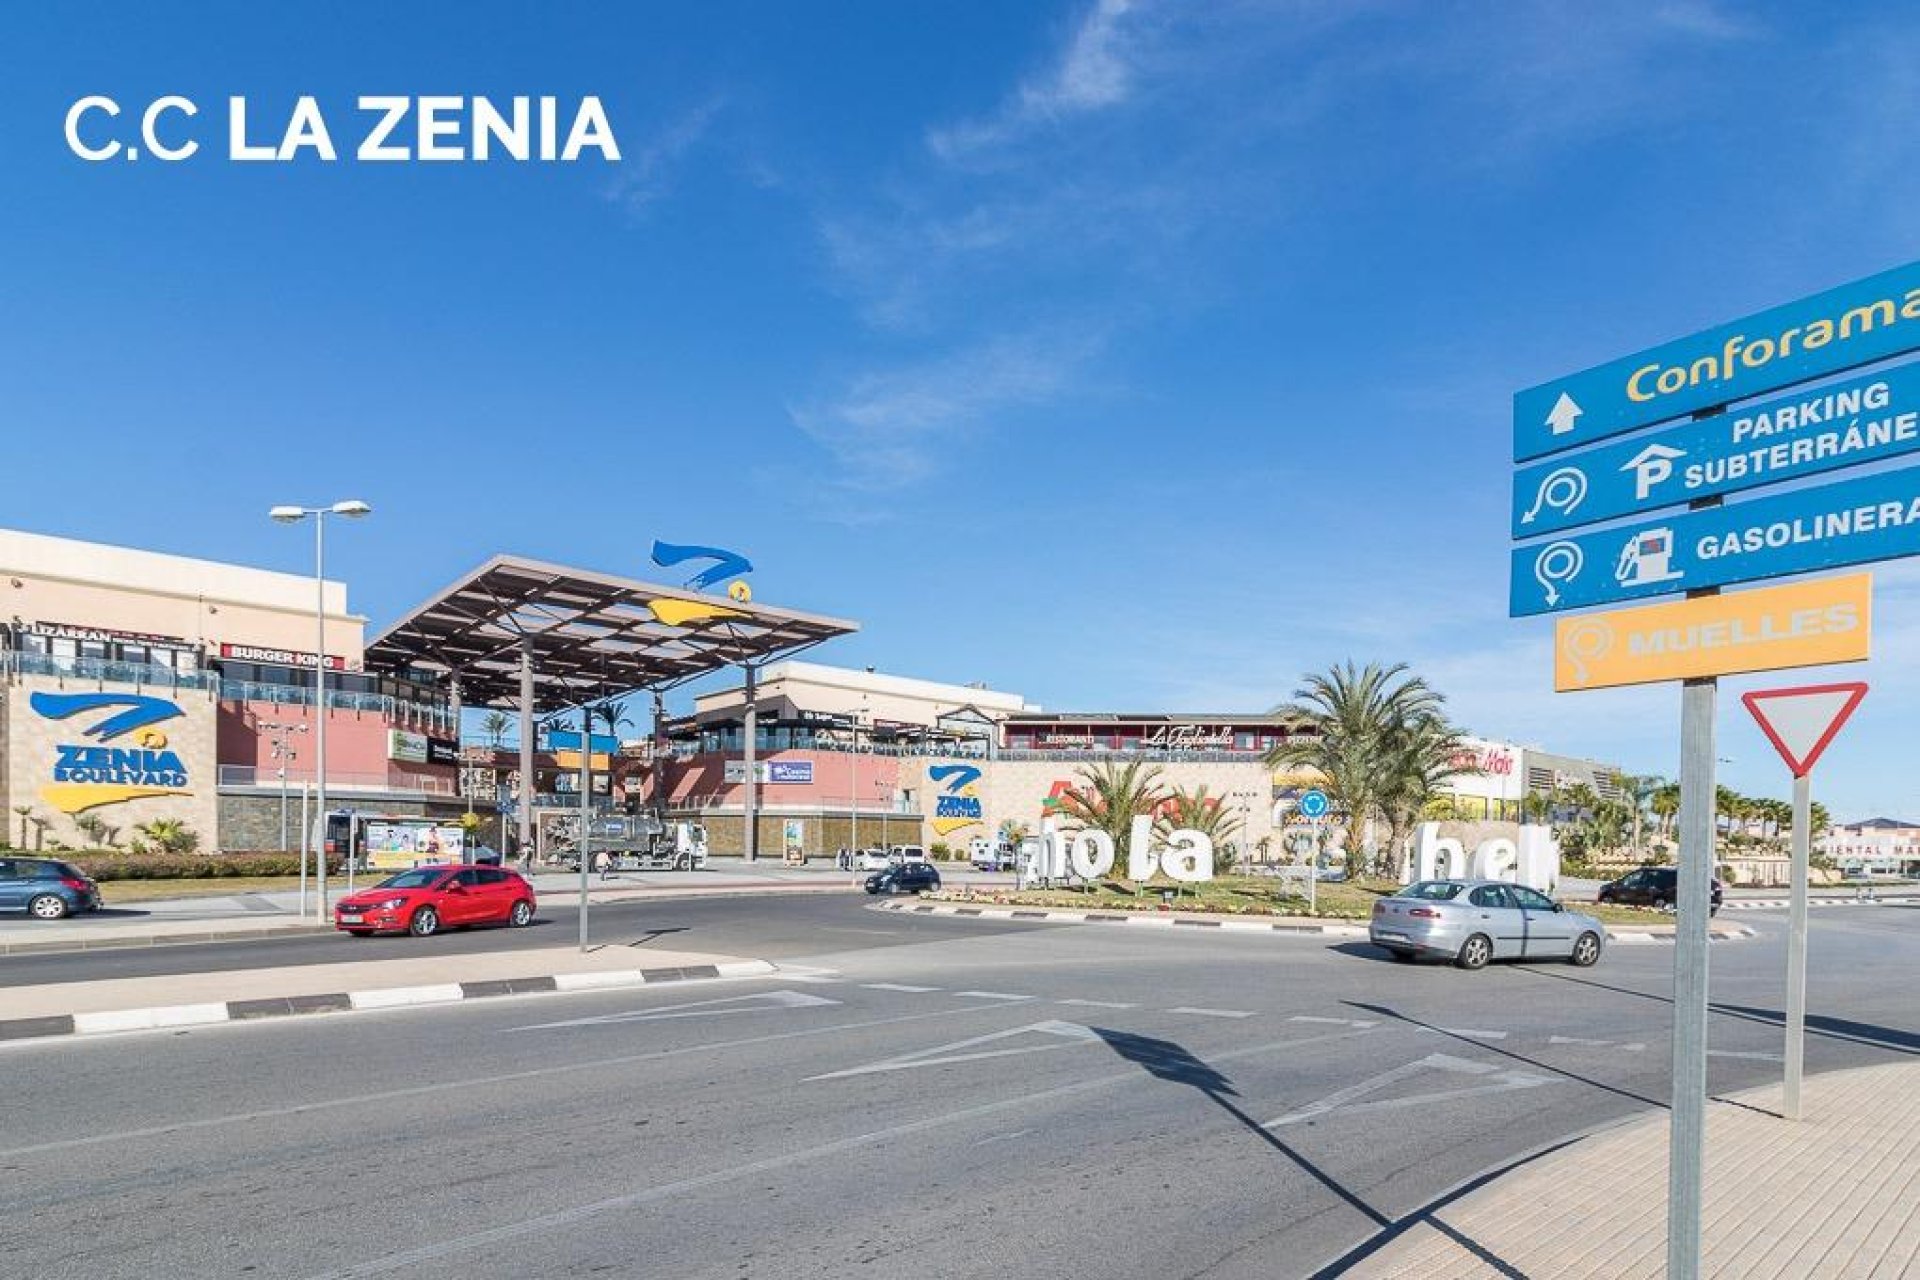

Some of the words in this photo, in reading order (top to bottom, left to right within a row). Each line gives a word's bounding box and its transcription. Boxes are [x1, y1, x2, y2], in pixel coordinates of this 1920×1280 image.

[1626, 288, 1920, 402] Conforama
[1733, 382, 1890, 443] PARKING
[1697, 497, 1920, 560] GASOLINERA
[1628, 603, 1859, 656] MUELLES
[231, 645, 292, 664] BURGER
[298, 653, 335, 668] KING
[54, 767, 188, 787] BOULEVARD
[55, 745, 188, 774] ZENIA
